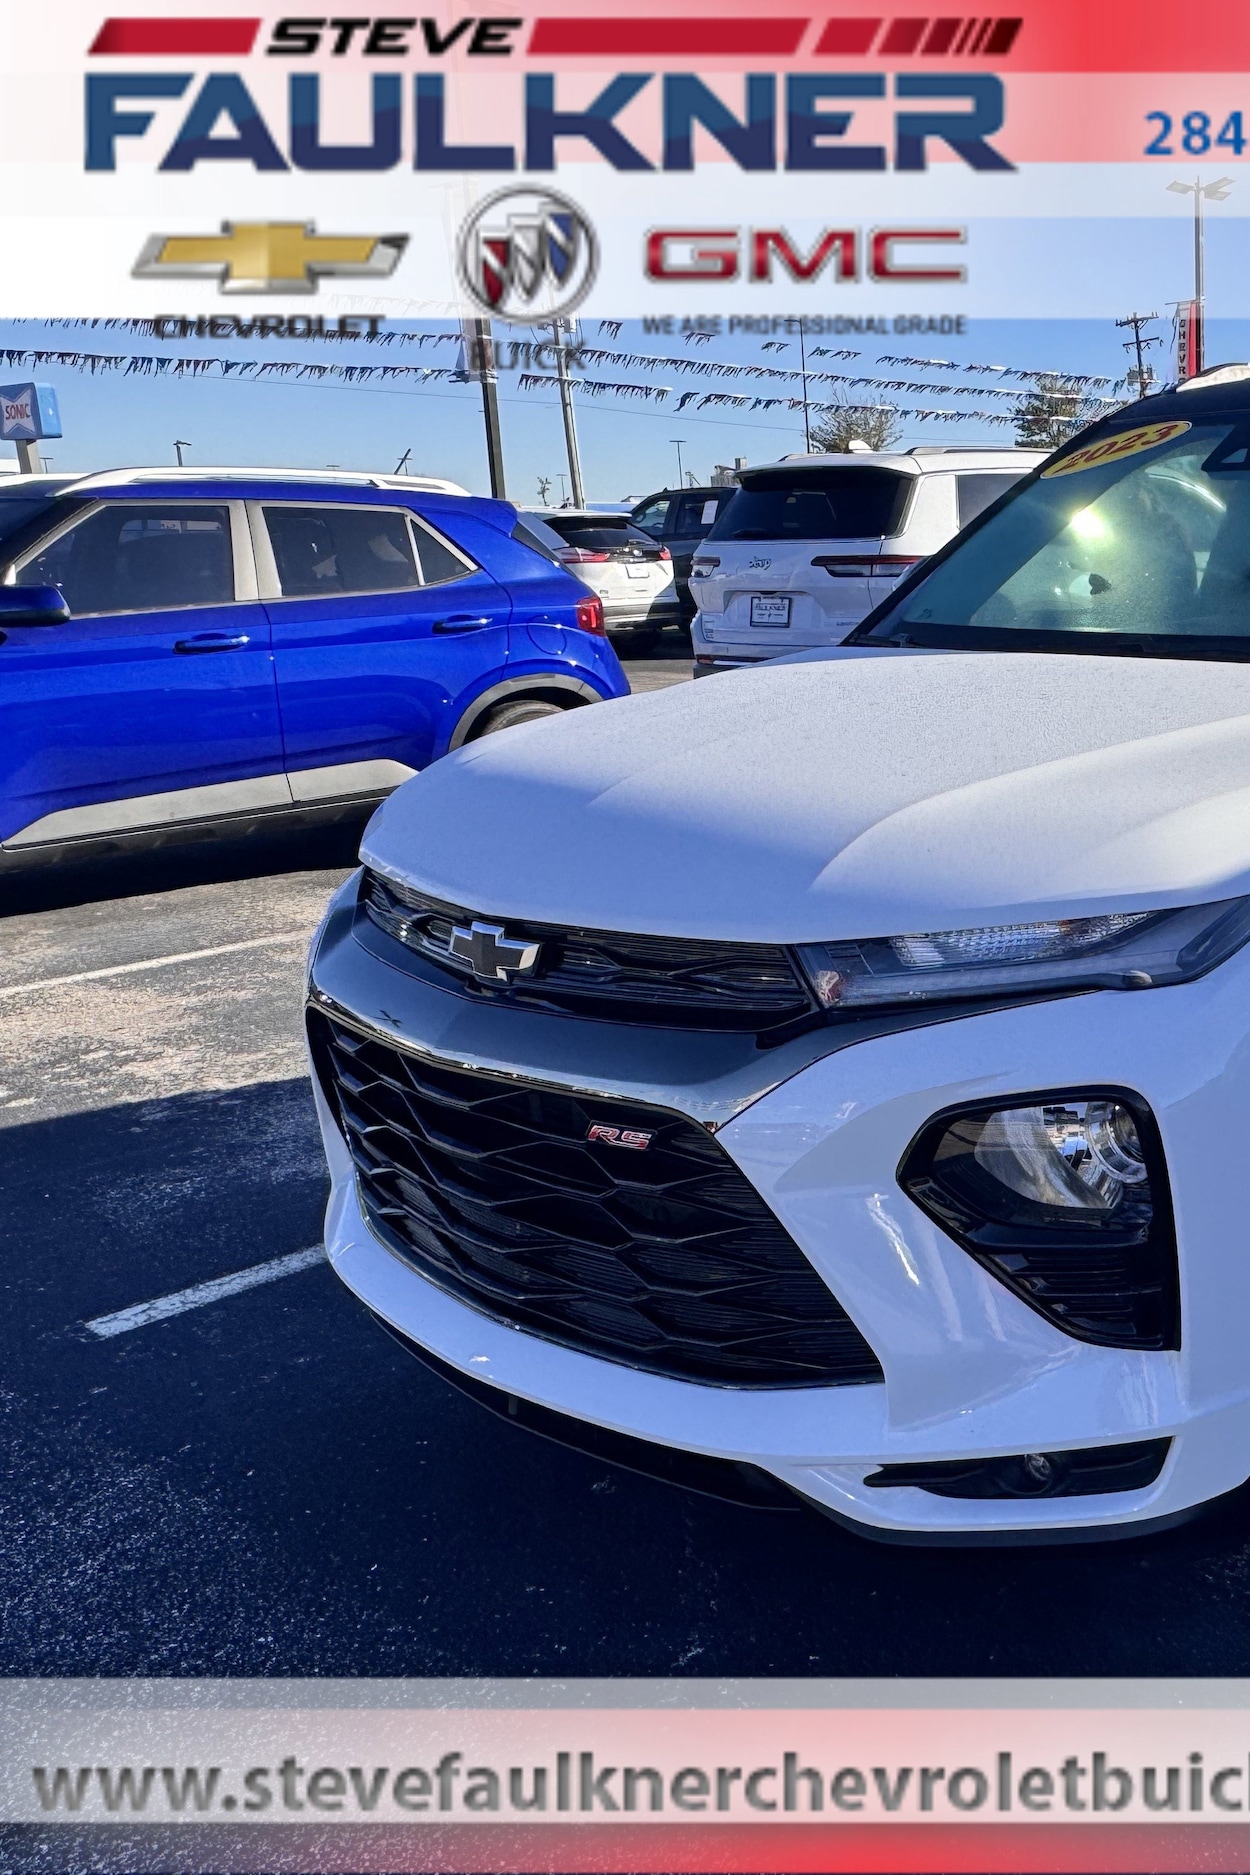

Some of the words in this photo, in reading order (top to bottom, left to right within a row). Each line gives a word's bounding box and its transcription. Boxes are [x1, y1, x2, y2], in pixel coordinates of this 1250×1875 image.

[5, 404, 30, 420] SONIC
[1053, 424, 1179, 475] 2023
[588, 1125, 652, 1150] RS
